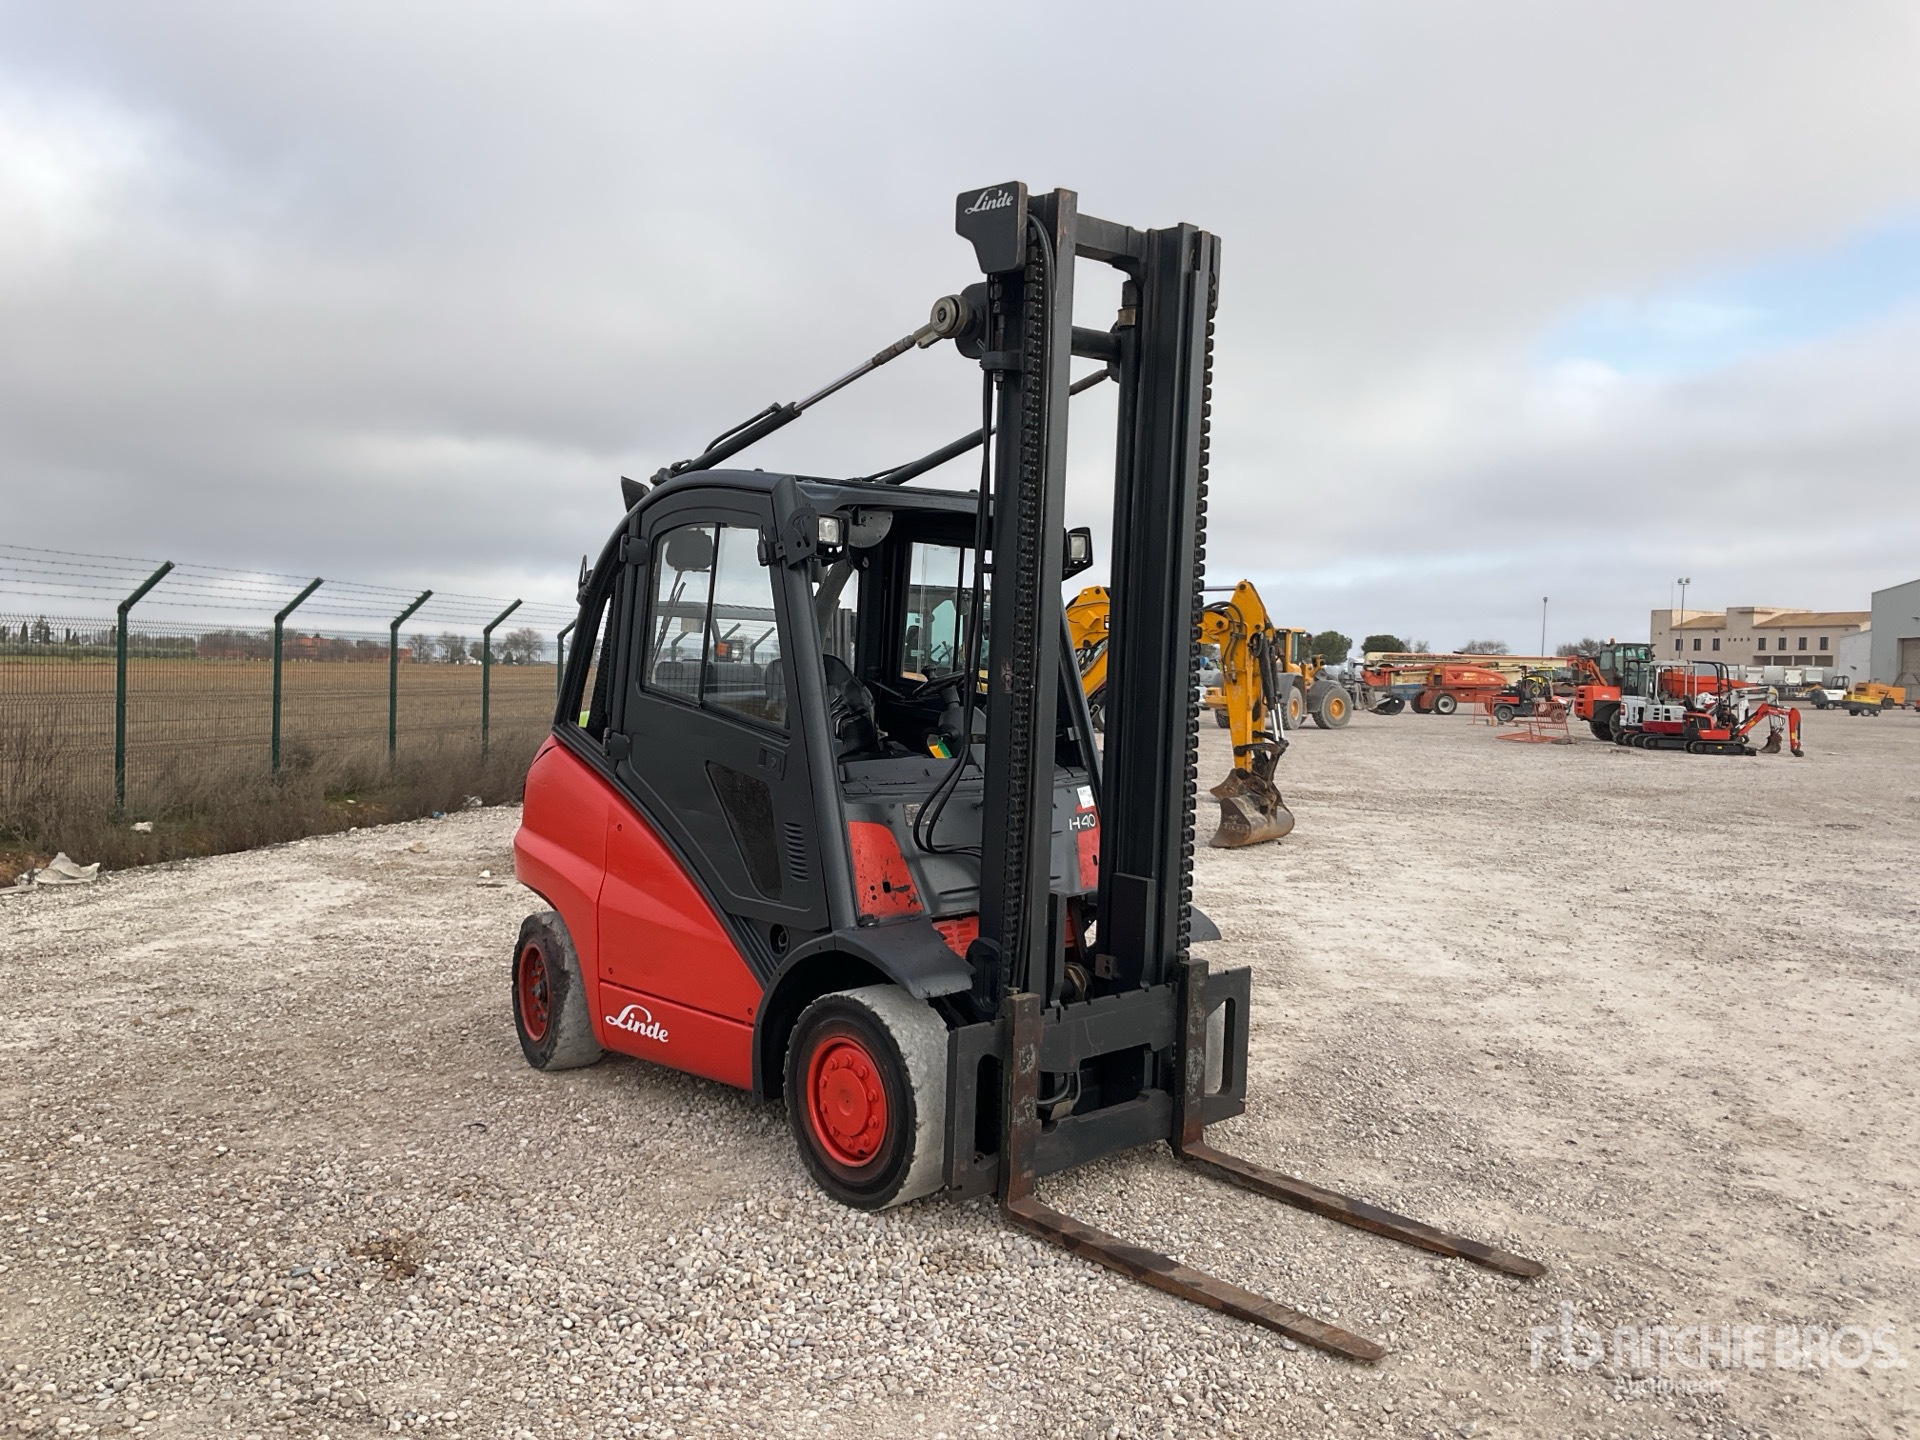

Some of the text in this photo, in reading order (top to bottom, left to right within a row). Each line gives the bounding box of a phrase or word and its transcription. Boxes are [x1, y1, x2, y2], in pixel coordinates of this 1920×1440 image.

[964, 187, 1014, 215] Linde
[1068, 813, 1096, 831] H40
[605, 1004, 669, 1043] Linde
